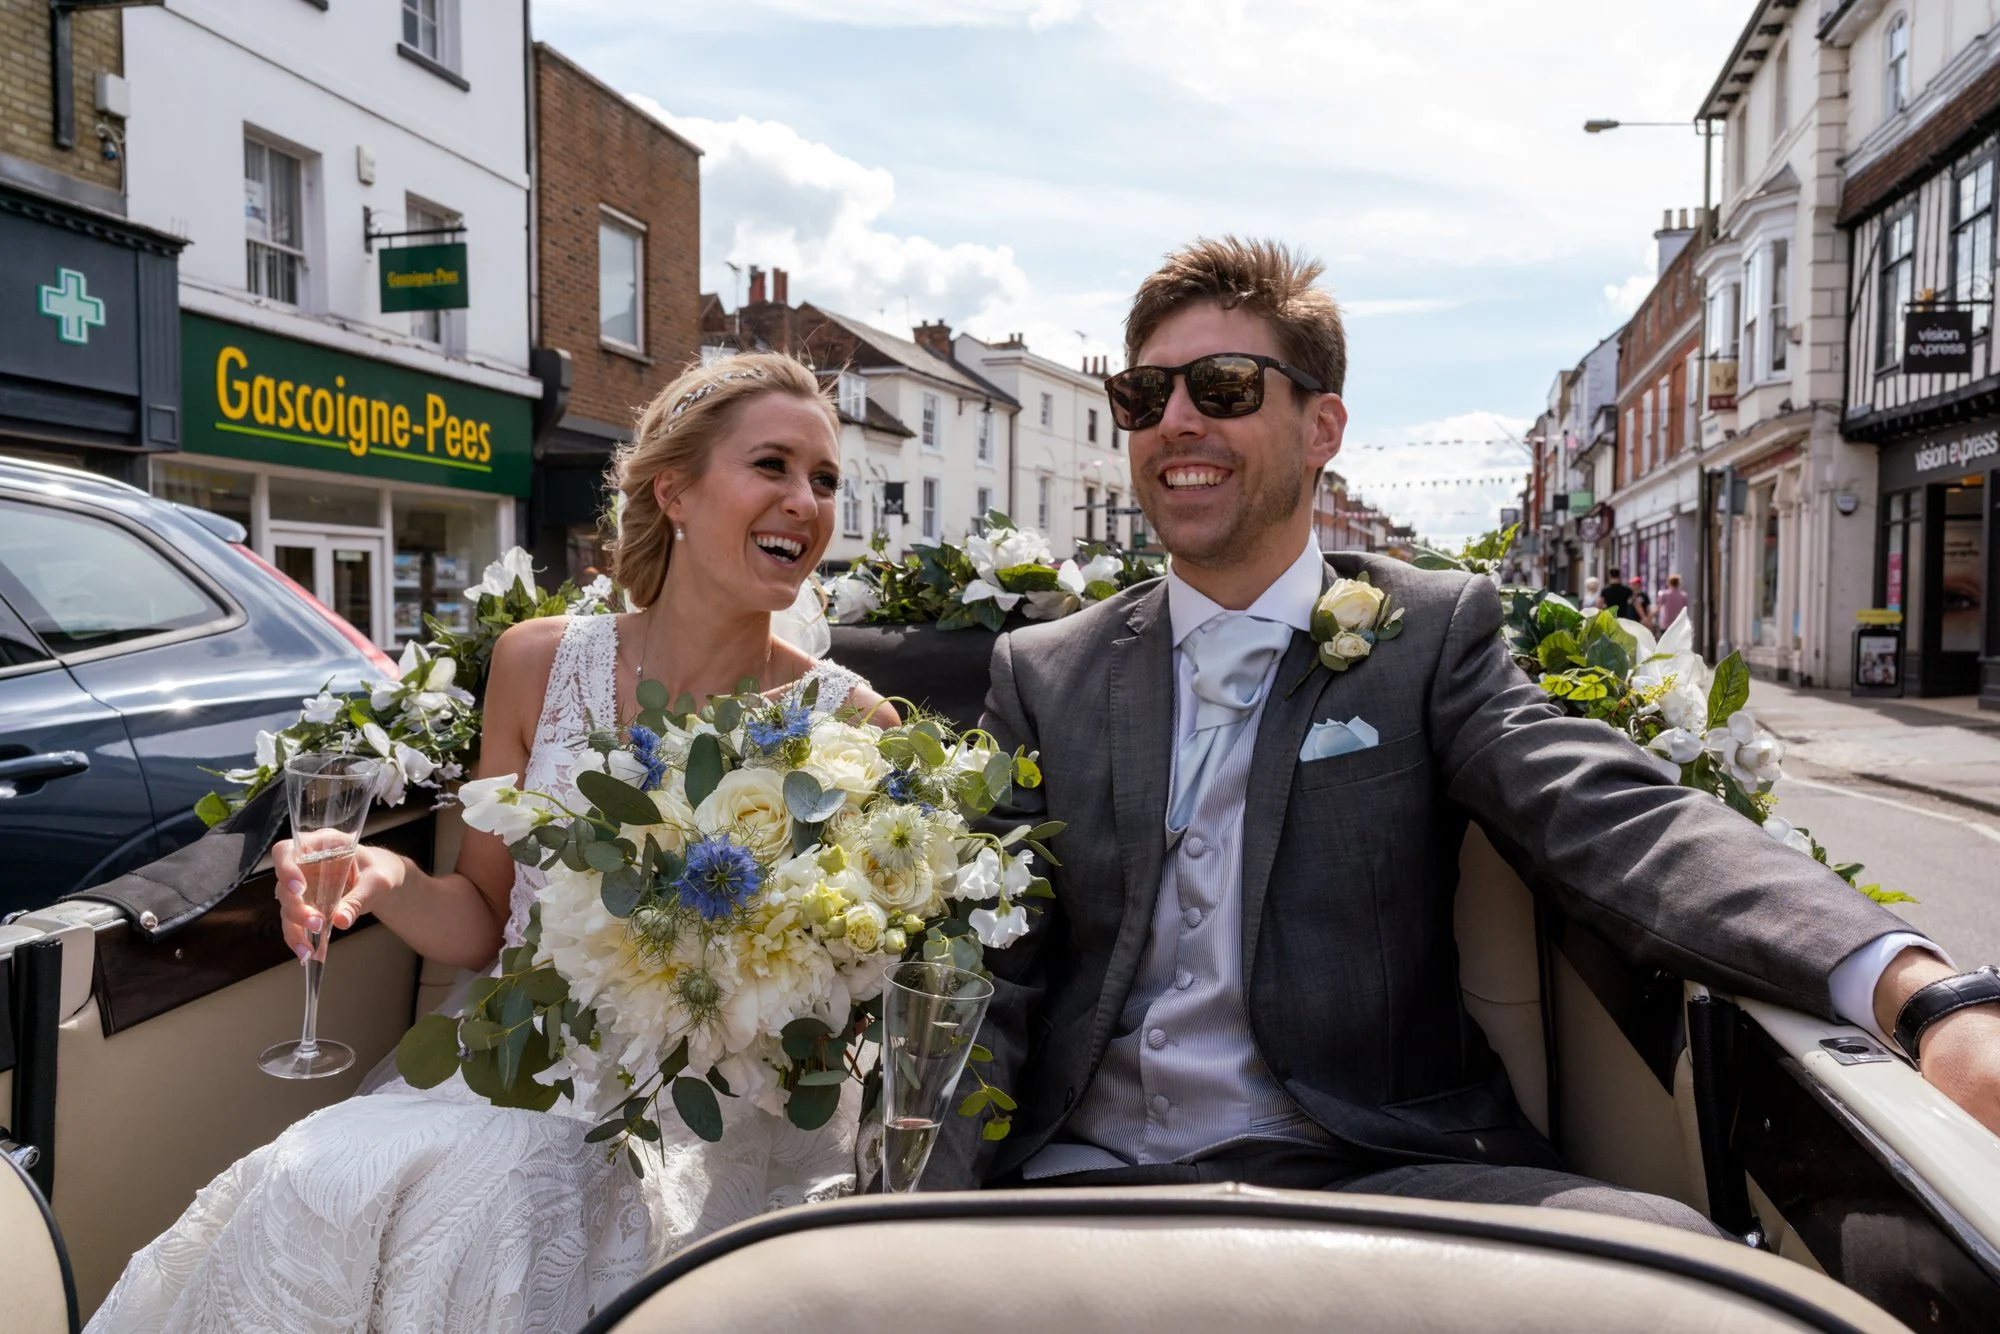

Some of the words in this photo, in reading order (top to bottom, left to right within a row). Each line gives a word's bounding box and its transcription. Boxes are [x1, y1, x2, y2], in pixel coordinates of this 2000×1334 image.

[1918, 326, 1960, 341] vision
[216, 346, 491, 462] Gascoigne-Pees
[1915, 440, 1948, 472] vision
